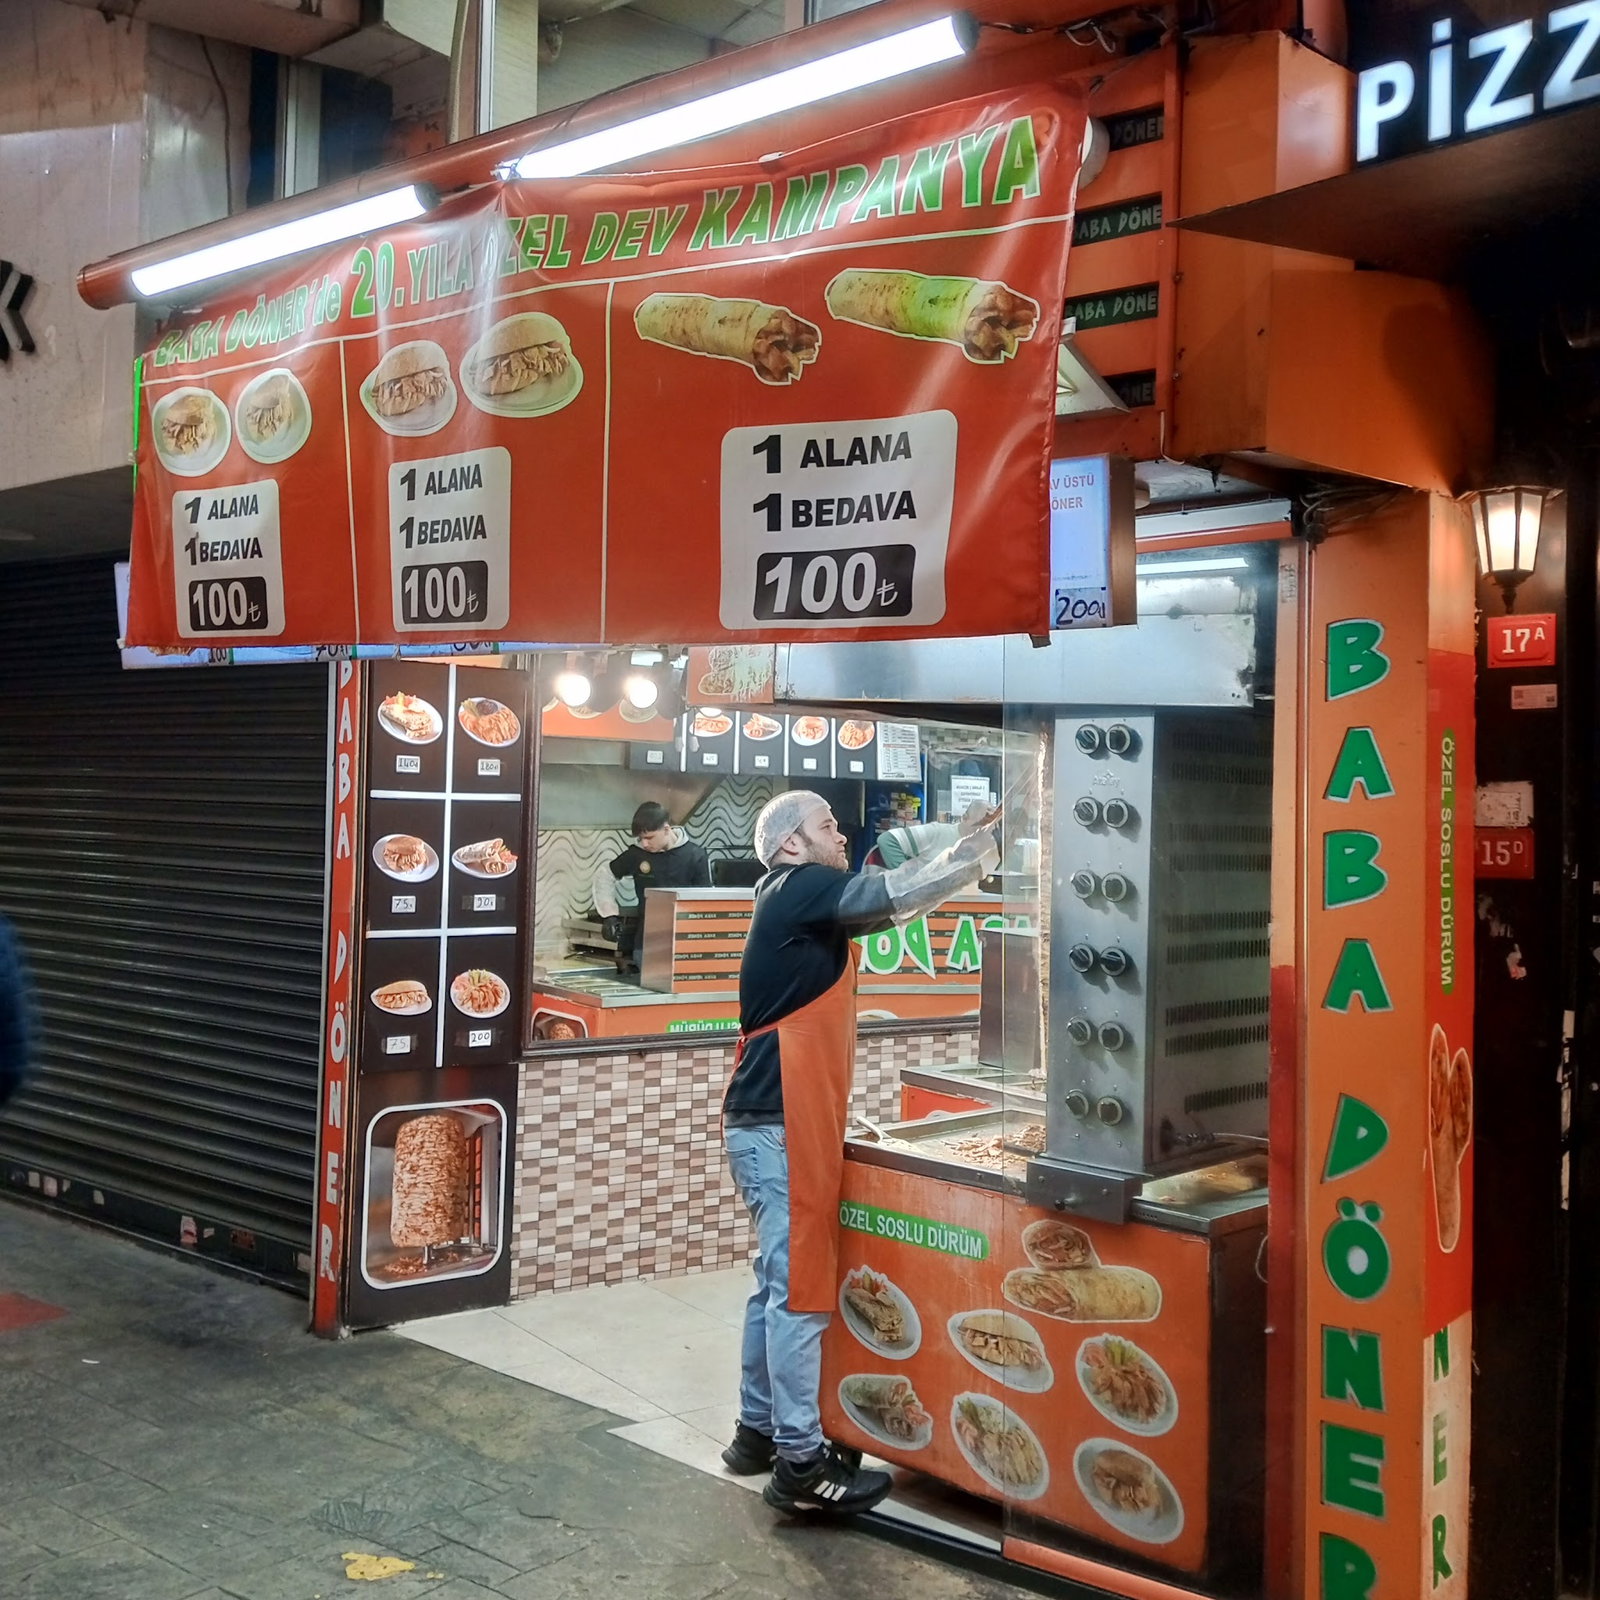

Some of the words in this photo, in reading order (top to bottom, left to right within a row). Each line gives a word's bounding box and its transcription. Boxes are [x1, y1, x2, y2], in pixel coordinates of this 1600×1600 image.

[153, 316, 226, 368] BABA
[583, 204, 688, 264] DEV
[688, 115, 1041, 250] KAMPANYA
[1075, 216, 1112, 239] ABA
[753, 434, 781, 473] 1
[800, 431, 912, 469] ALANA
[400, 467, 417, 501] 1
[424, 463, 483, 496] ALANA
[1064, 471, 1095, 489] ÜSTÜ
[184, 497, 202, 524] 1
[207, 494, 259, 521] ALANA
[753, 493, 782, 532] 1
[792, 490, 917, 529] BEDAVA
[1051, 496, 1084, 512] ÖNER
[184, 537, 198, 565] 1
[199, 537, 263, 562] BEDAVA
[399, 516, 414, 548] 1
[416, 514, 487, 546] BEDAVA
[1440, 736, 1454, 798] ÖZEL
[1321, 617, 1396, 1014] BABA
[1440, 807, 1453, 888] SOSLU
[1440, 897, 1453, 987] DÜRÜM
[319, 930, 348, 1282] DÖNER
[839, 1202, 874, 1233] ÖZEL
[876, 1214, 924, 1245] SOSLU
[928, 1224, 982, 1260] DÜRÜM
[1318, 1091, 1392, 1600] DÖNER
